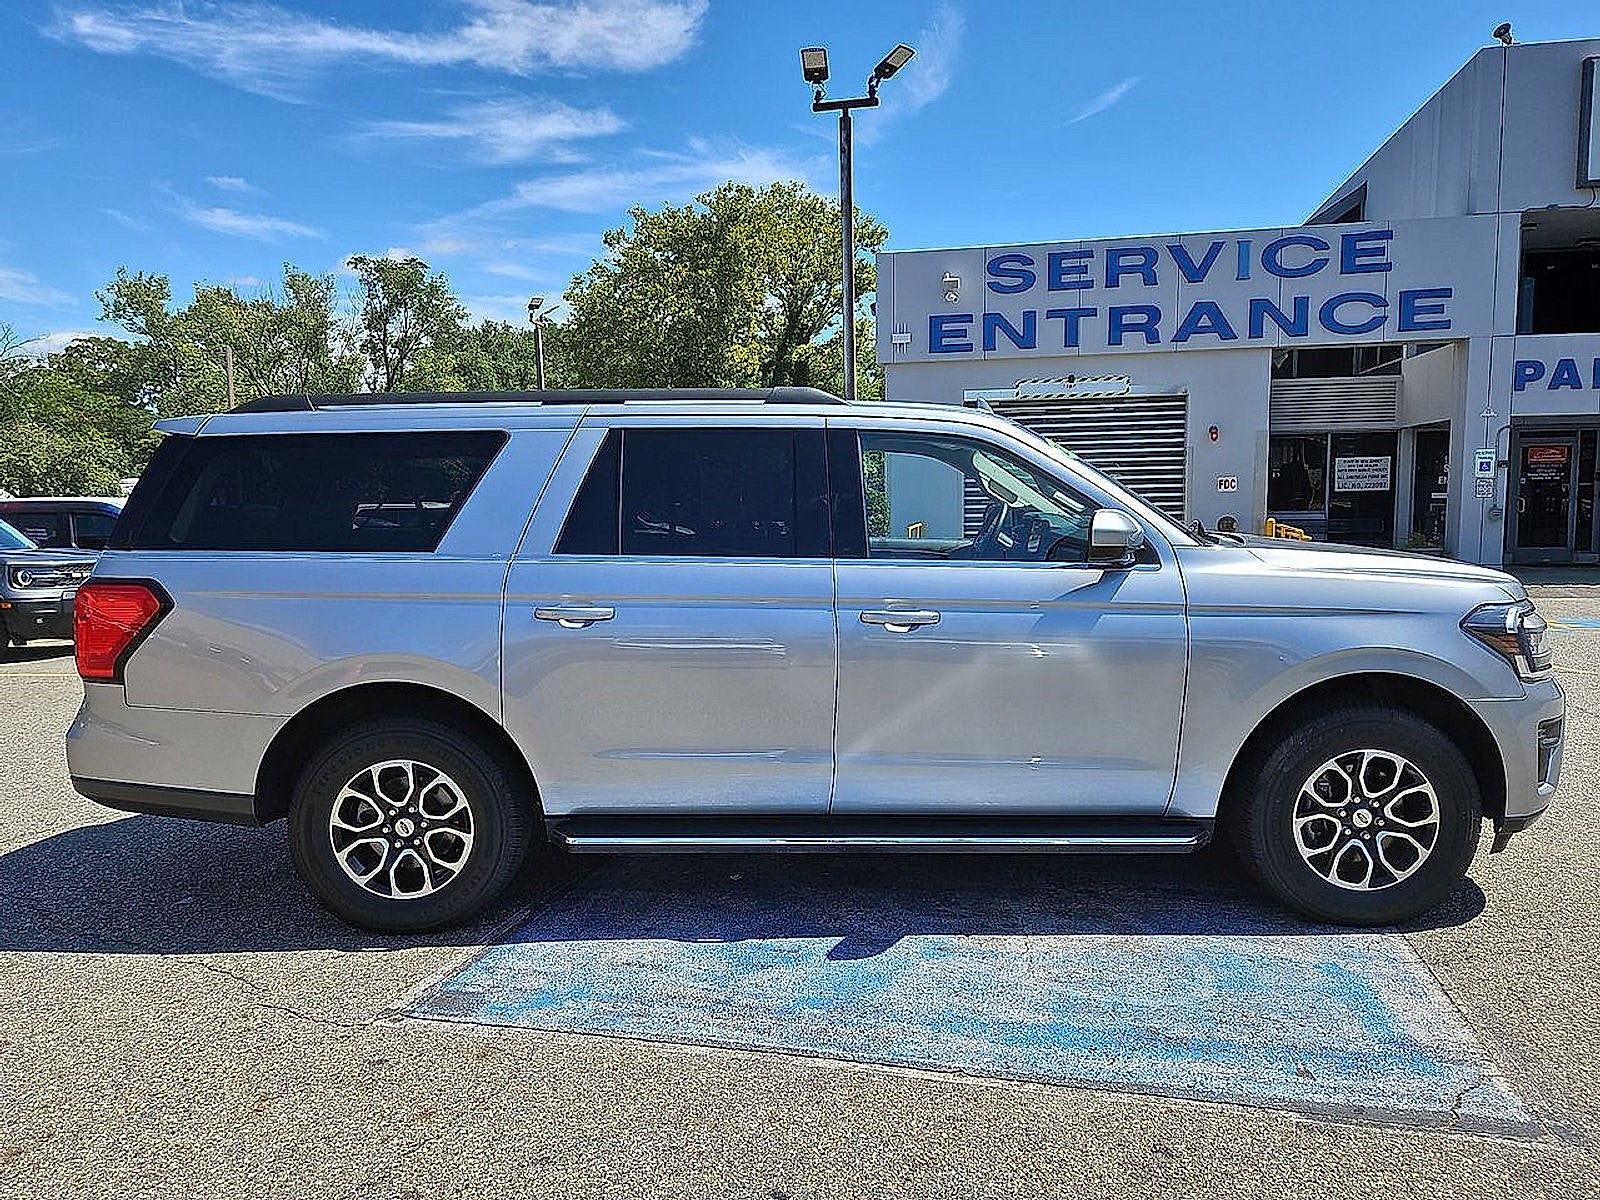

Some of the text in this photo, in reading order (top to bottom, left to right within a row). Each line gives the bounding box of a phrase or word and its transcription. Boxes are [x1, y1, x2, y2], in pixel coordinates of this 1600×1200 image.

[986, 229, 1394, 295] SERVICE
[928, 287, 1453, 354] ENTRANCE
[1218, 478, 1237, 490] FDC
